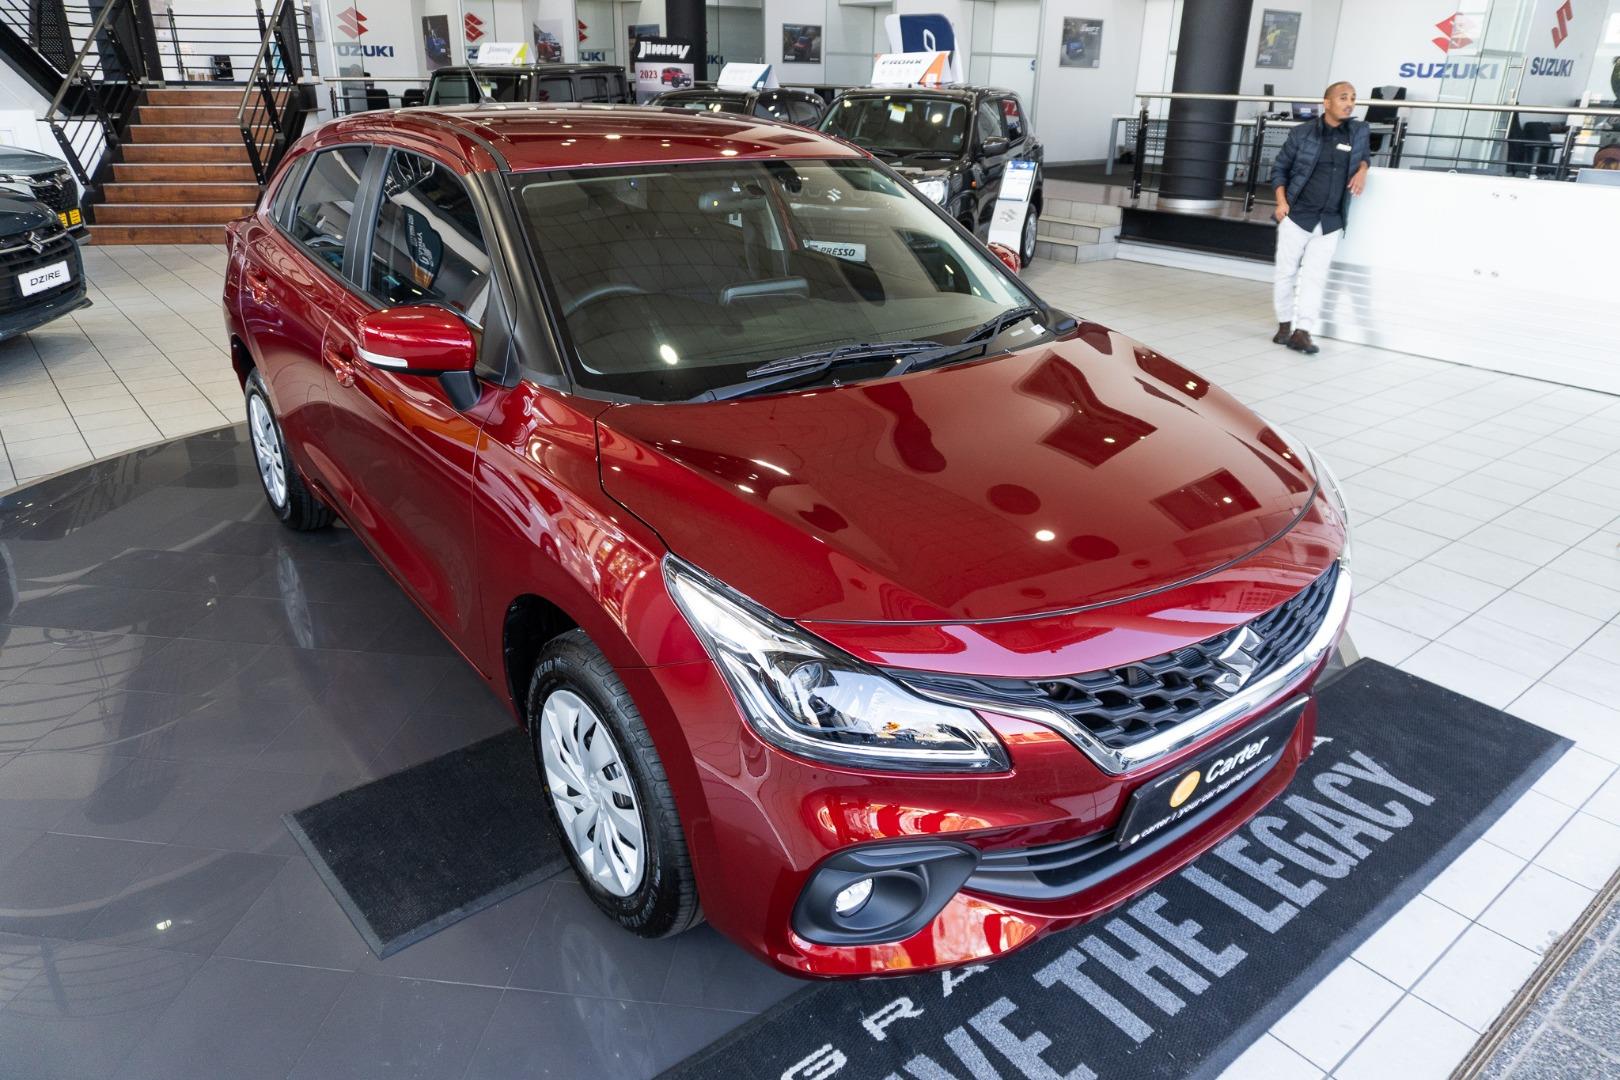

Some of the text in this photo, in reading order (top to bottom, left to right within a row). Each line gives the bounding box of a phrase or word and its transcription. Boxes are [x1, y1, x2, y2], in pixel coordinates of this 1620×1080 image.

[337, 45, 394, 57] UZUKI
[637, 41, 691, 59] Jimny
[640, 70, 658, 79] 2023
[1399, 62, 1499, 80] SUZUKI
[1530, 56, 1574, 77] SUZUKI
[30, 270, 61, 286] DZIRE
[1205, 736, 1270, 783] Carter
[1032, 892, 1249, 1044] THE
[1180, 749, 1436, 934] LEGACY
